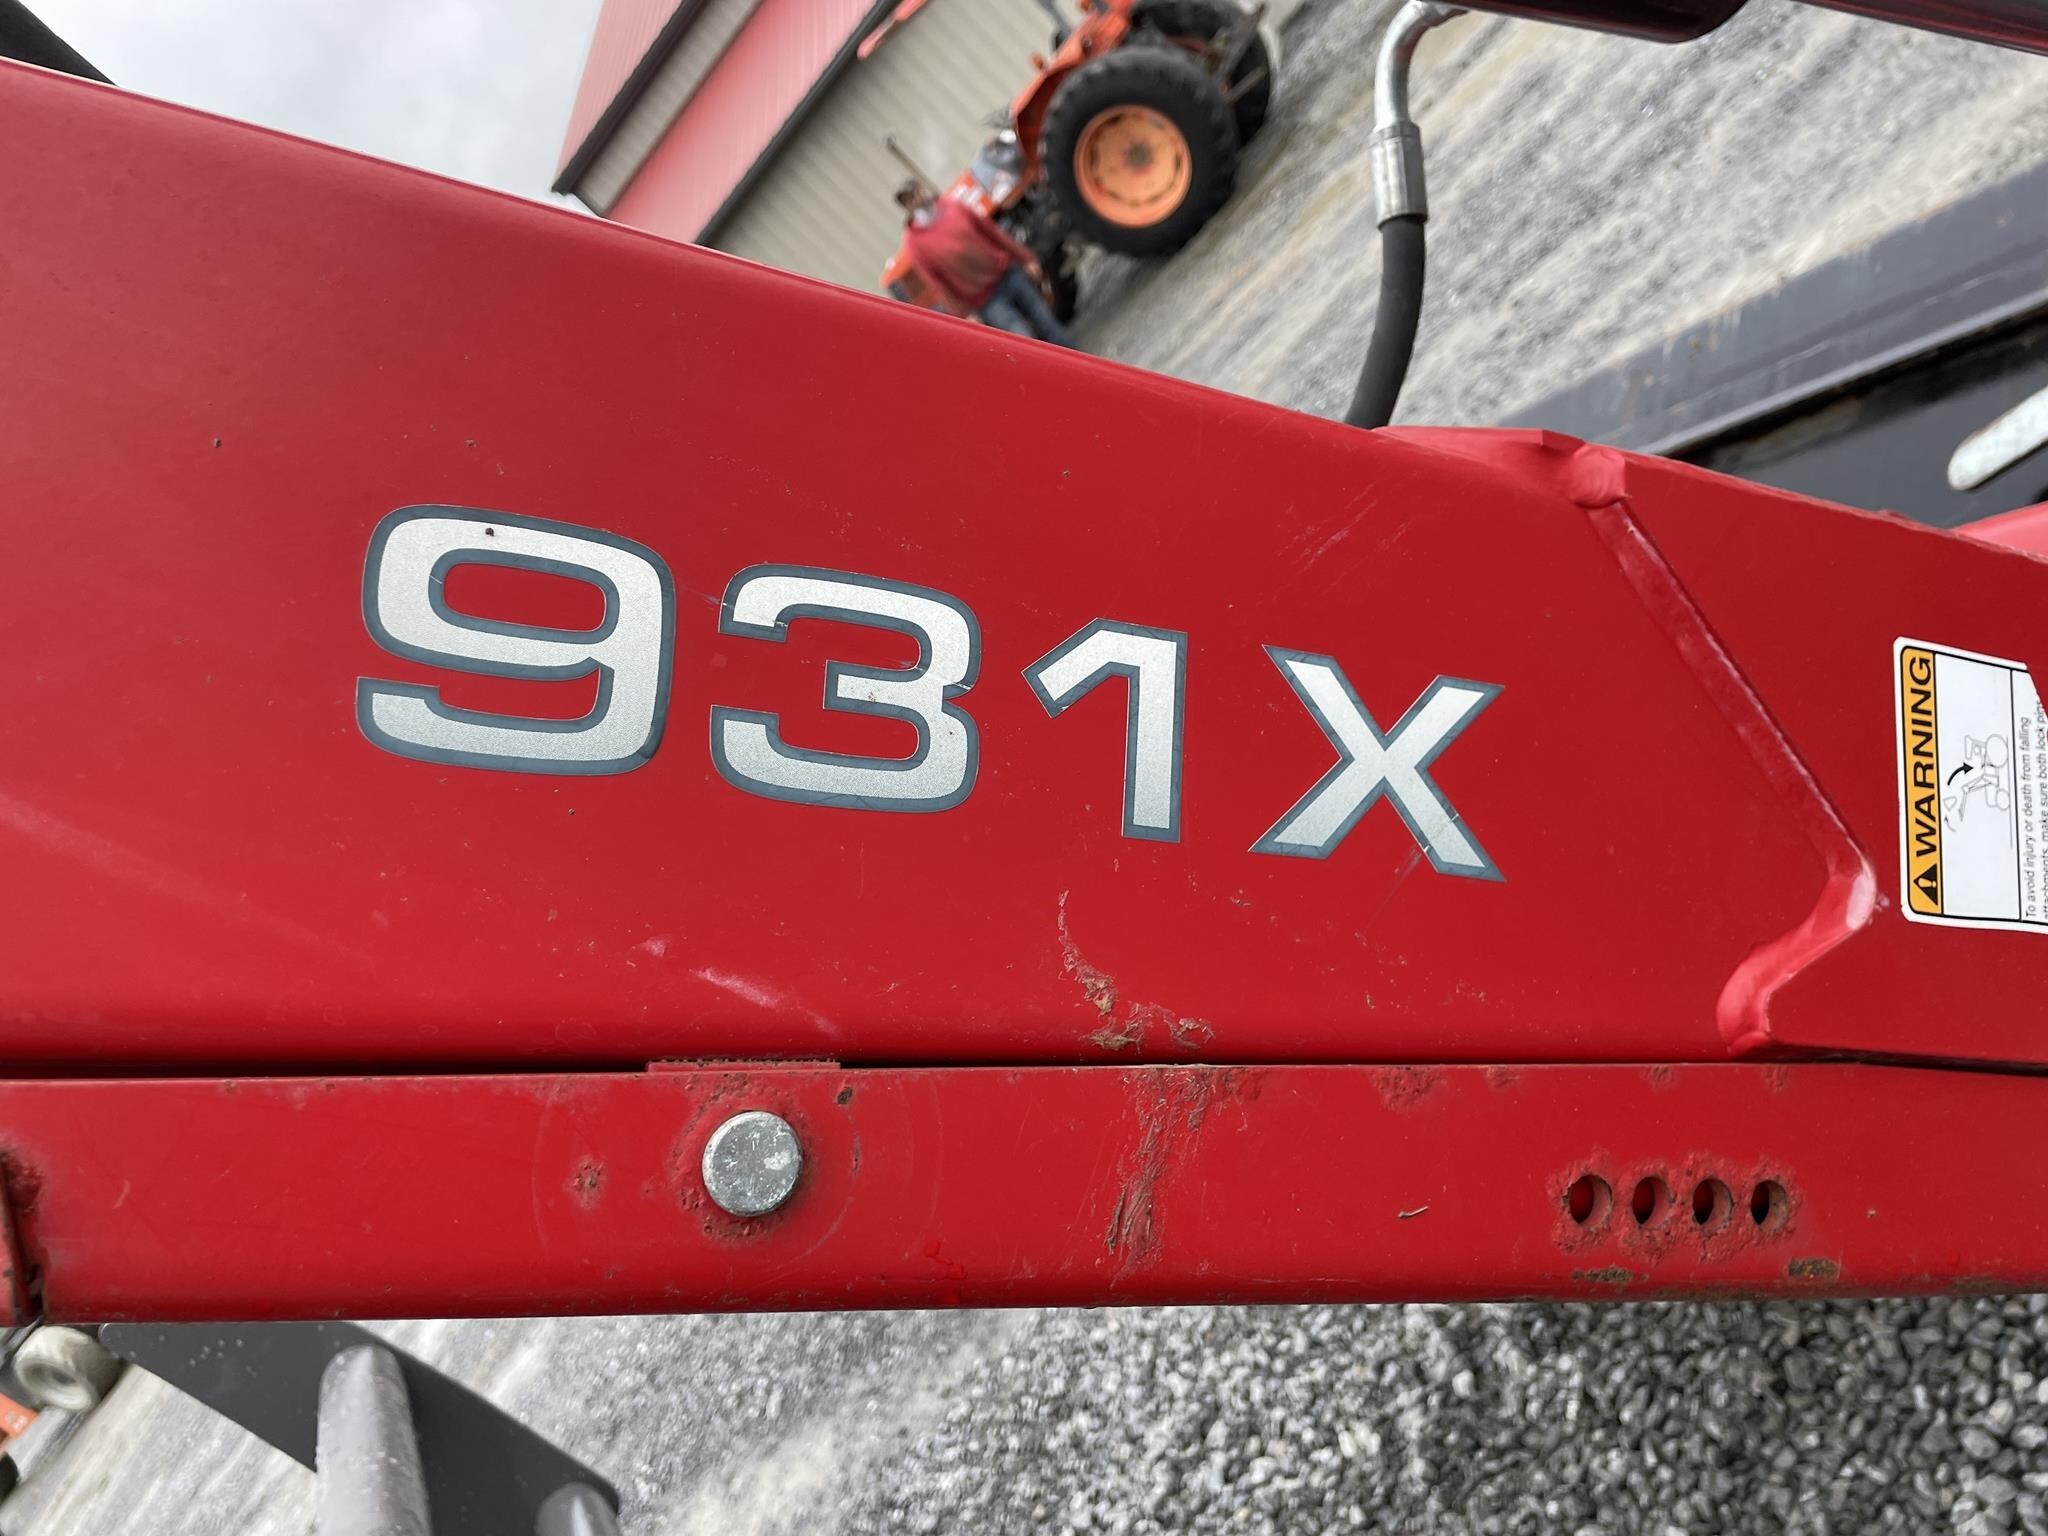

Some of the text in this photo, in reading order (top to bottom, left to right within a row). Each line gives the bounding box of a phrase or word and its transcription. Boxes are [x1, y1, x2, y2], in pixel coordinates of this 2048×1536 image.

[353, 503, 1506, 883] 931X
[2034, 726, 2046, 750] lock
[1908, 656, 1937, 858] WARNING
[2037, 753, 2048, 779] both
[2039, 783, 2048, 806] sure
[2018, 717, 2037, 917] To avoid injury or death from falling
